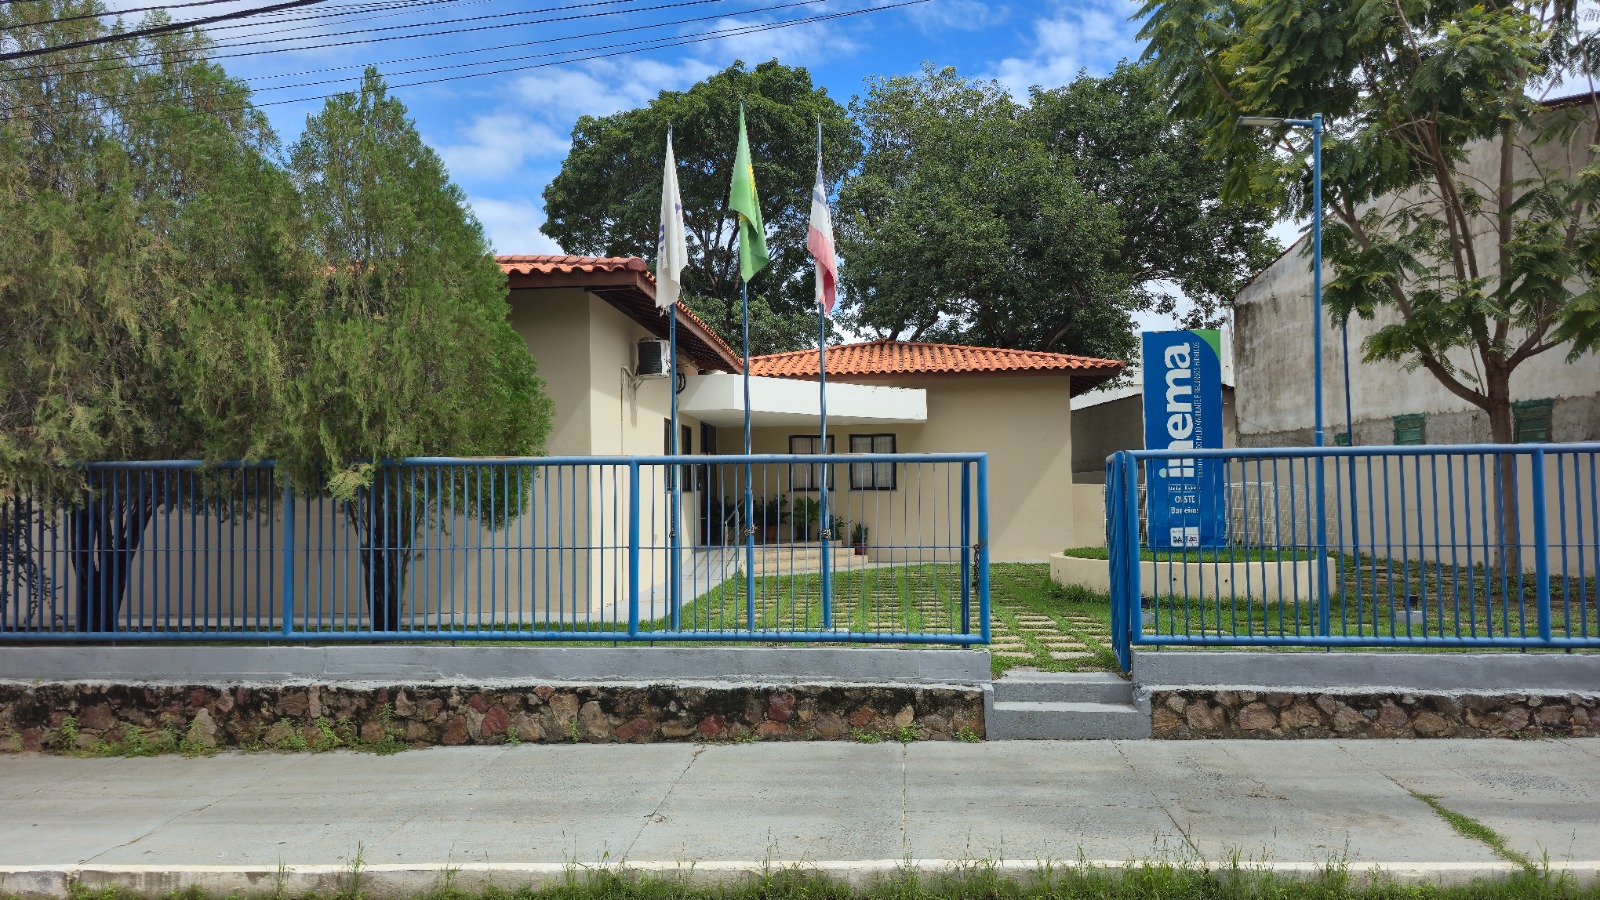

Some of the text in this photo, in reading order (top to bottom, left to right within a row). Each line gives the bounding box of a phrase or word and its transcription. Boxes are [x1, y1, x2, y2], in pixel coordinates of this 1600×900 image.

[1193, 367, 1201, 394] RECURSOS
[1159, 342, 1194, 478] inema
[1170, 506, 1199, 514] Bareiras
